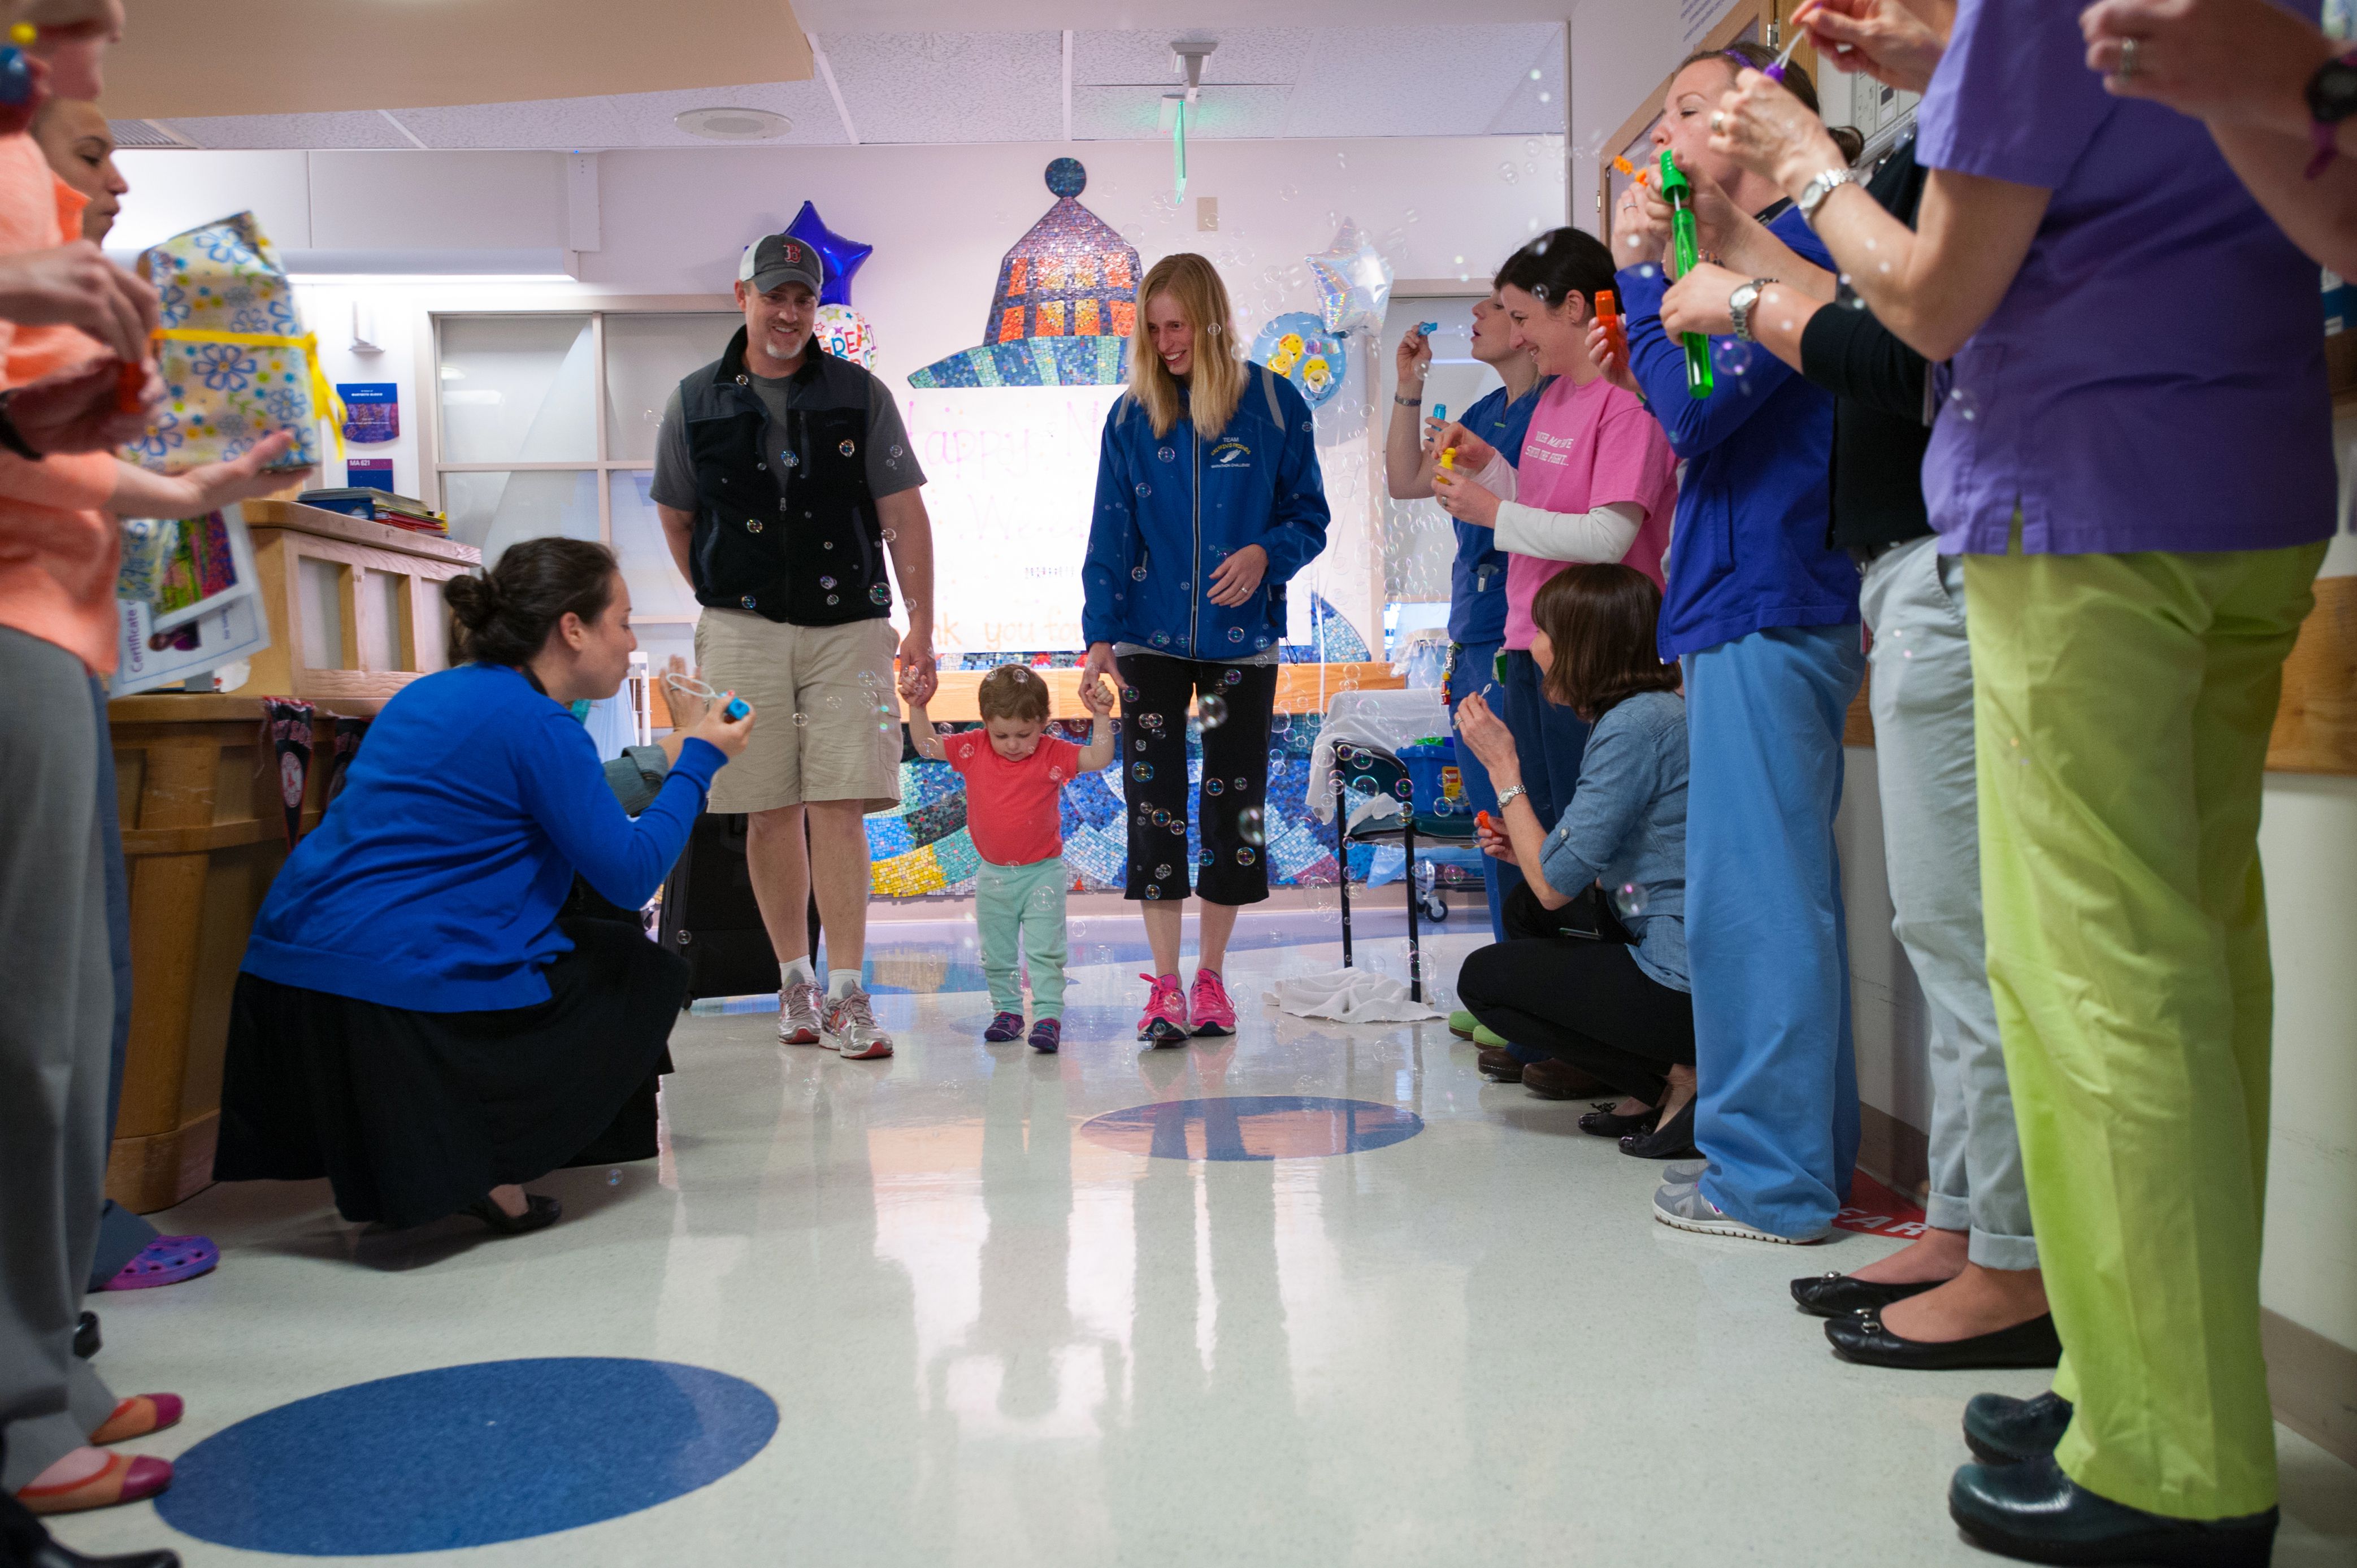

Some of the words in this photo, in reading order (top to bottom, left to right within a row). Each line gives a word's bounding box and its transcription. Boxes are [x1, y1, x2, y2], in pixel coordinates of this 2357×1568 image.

[783, 244, 801, 264] B
[127, 609, 144, 672] Certificate
[984, 620, 1036, 651] you
